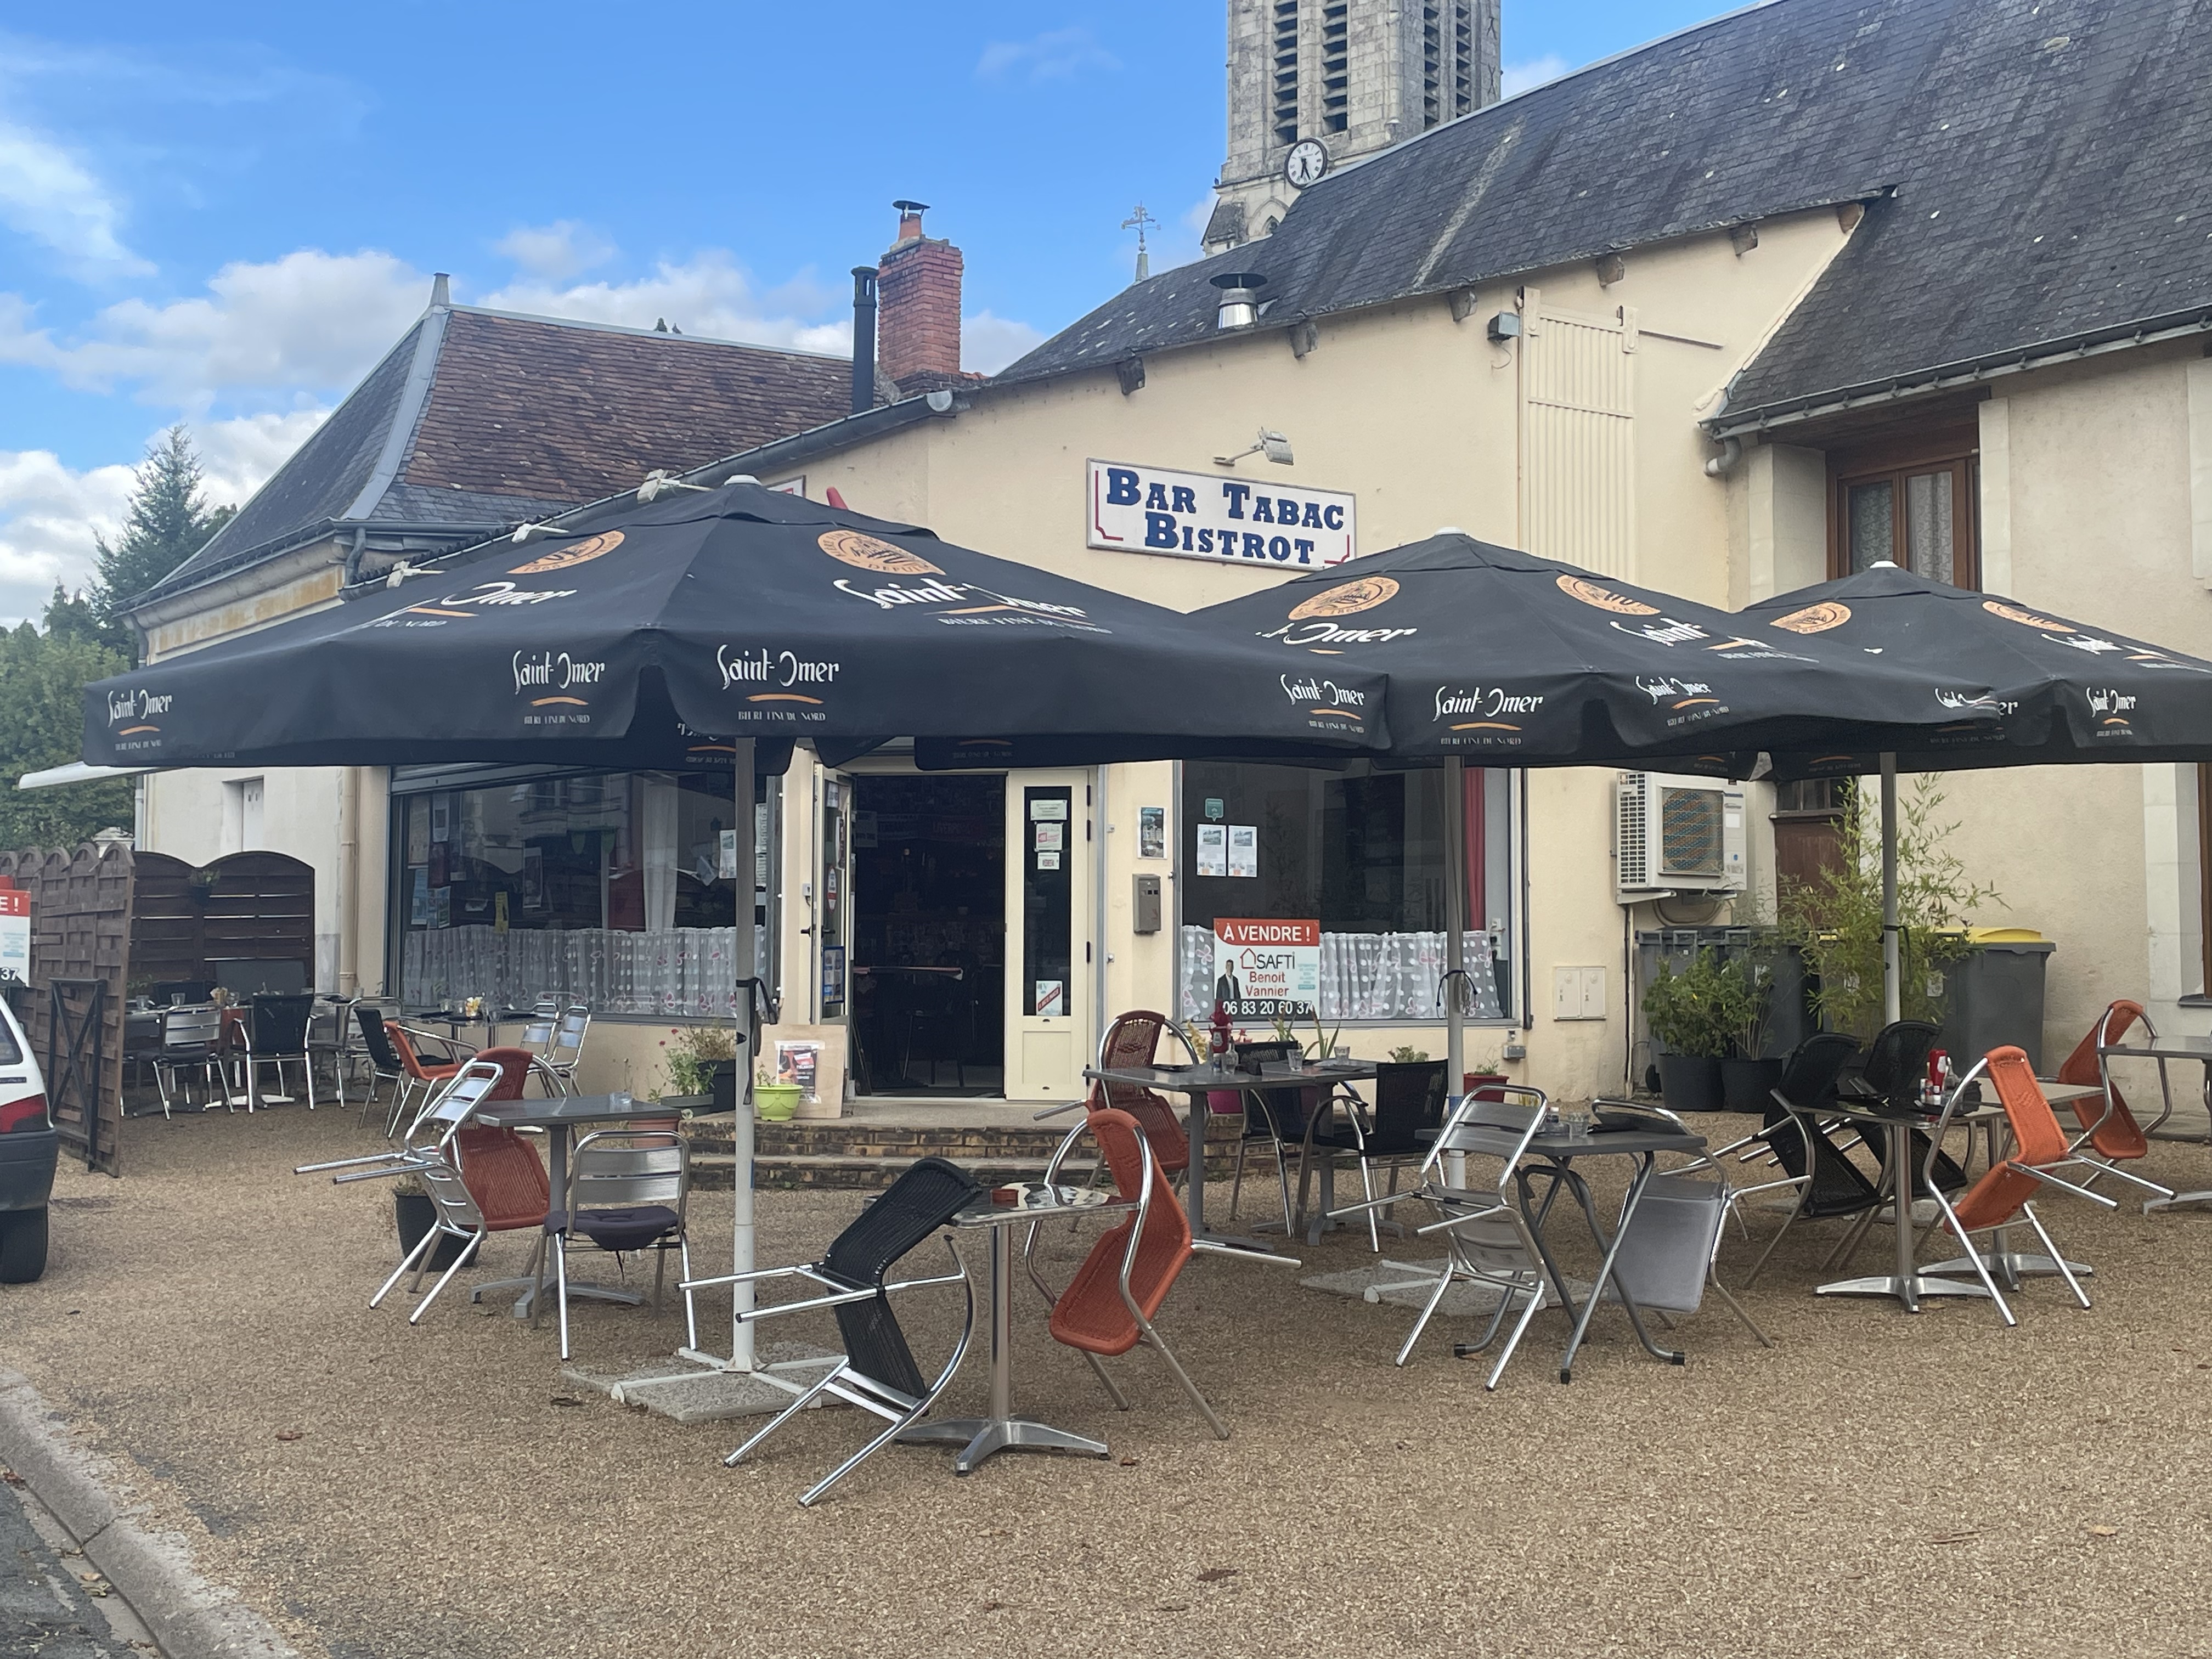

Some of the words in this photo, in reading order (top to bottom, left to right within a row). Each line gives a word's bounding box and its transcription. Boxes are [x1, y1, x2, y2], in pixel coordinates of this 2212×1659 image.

[1107, 467, 1197, 514] BAR
[1223, 483, 1344, 531] TABAC
[1144, 511, 1314, 564] BISTROT
[1238, 925, 1302, 942] VENDRE
[1, 967, 20, 981] 37
[1249, 971, 1285, 983] Benoit
[1245, 985, 1289, 996] Vannier
[1241, 1001, 1256, 1015] 83
[1260, 1001, 1275, 1015] 20
[1296, 1001, 1312, 1015] 37
